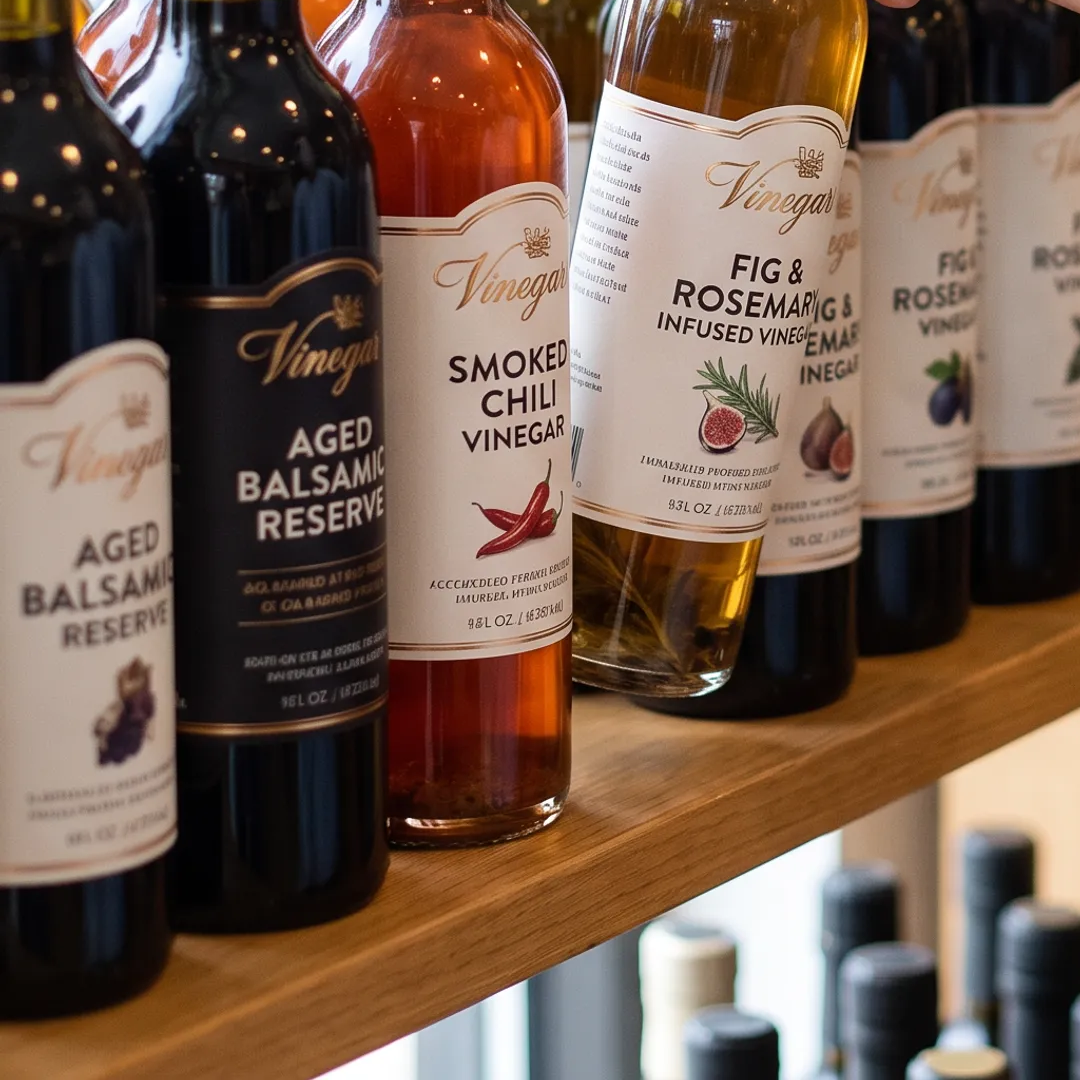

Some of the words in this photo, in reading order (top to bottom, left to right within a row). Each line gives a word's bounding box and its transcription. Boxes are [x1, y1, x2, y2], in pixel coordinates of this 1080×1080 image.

[705, 159, 837, 235] Vinegar
[433, 242, 567, 321] Vinegar
[730, 254, 783, 285] FIG
[788, 259, 804, 285] &
[672, 279, 820, 320] ROSEMARY
[813, 296, 837, 323] IG
[657, 312, 754, 345] INFUSED
[759, 325, 811, 347] VINEG
[449, 339, 568, 384] SMOKED
[481, 379, 556, 418] CHILI
[287, 416, 373, 461] AGED
[461, 414, 565, 453] VINEGAR
[237, 445, 385, 503] BALSAMIC
[257, 485, 385, 542] RESERVE
[694, 503, 713, 516] OZ
[74, 520, 160, 570] AGED
[62, 598, 169, 649] RESERVE
